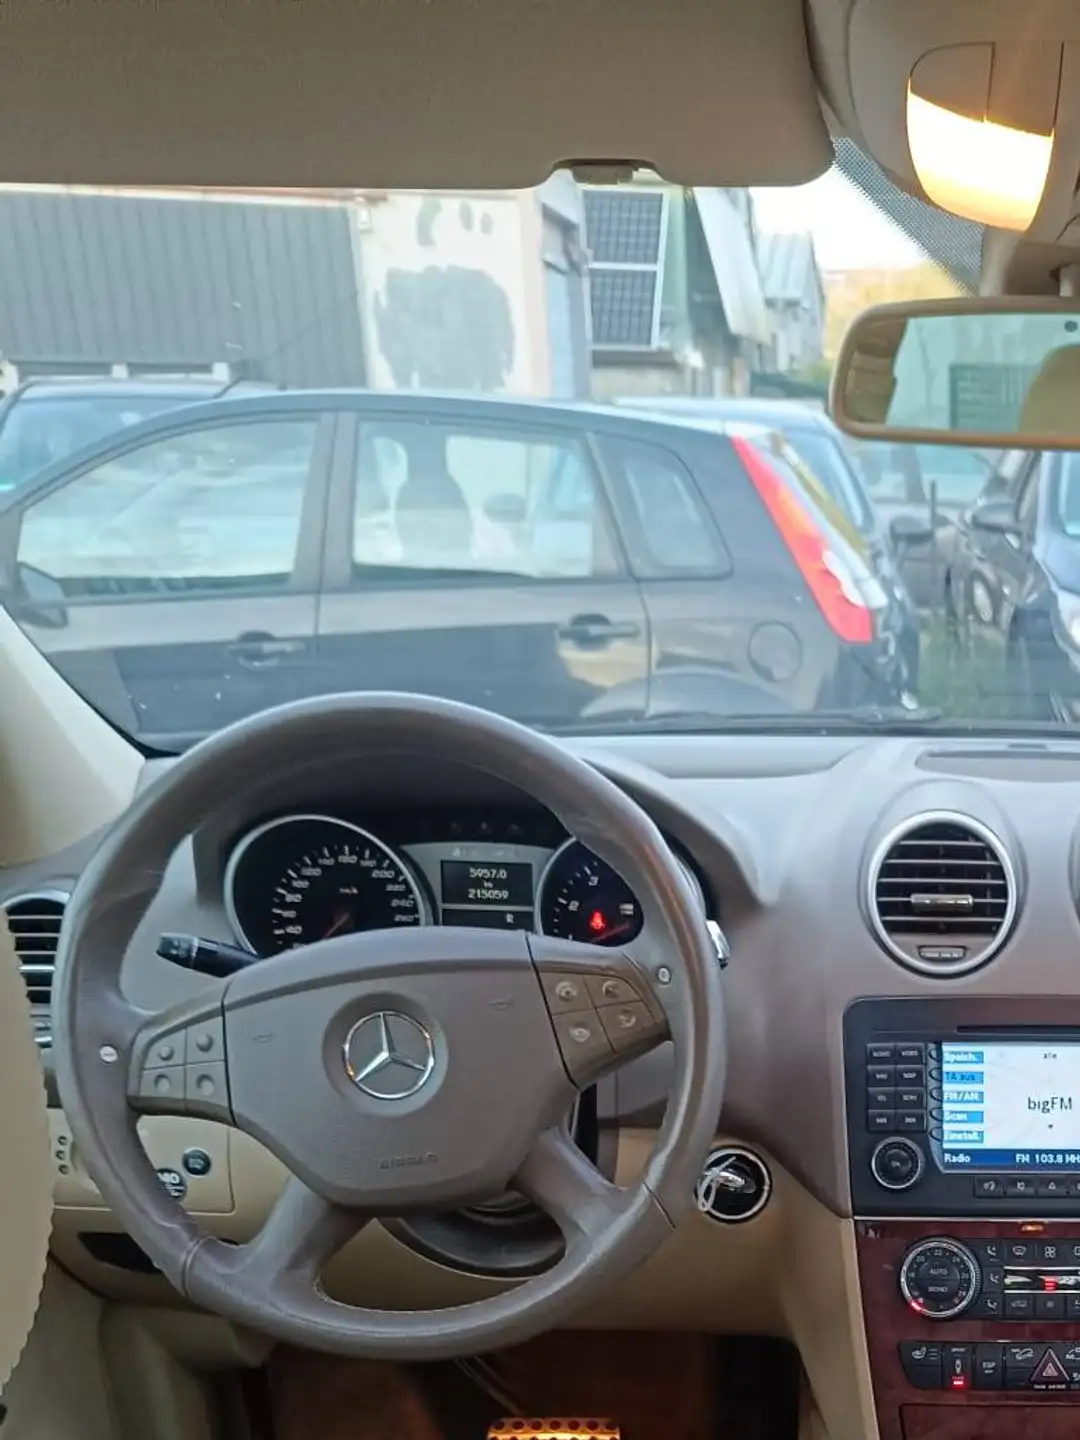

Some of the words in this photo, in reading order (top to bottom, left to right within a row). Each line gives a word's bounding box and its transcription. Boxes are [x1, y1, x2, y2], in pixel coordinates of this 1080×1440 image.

[588, 876, 599, 886] 3
[945, 1072, 958, 1081] TA
[1027, 1096, 1073, 1114] bigFM
[944, 1153, 971, 1163] Radio
[1015, 1153, 1031, 1163] FM
[1035, 1153, 1063, 1164] 103.8
